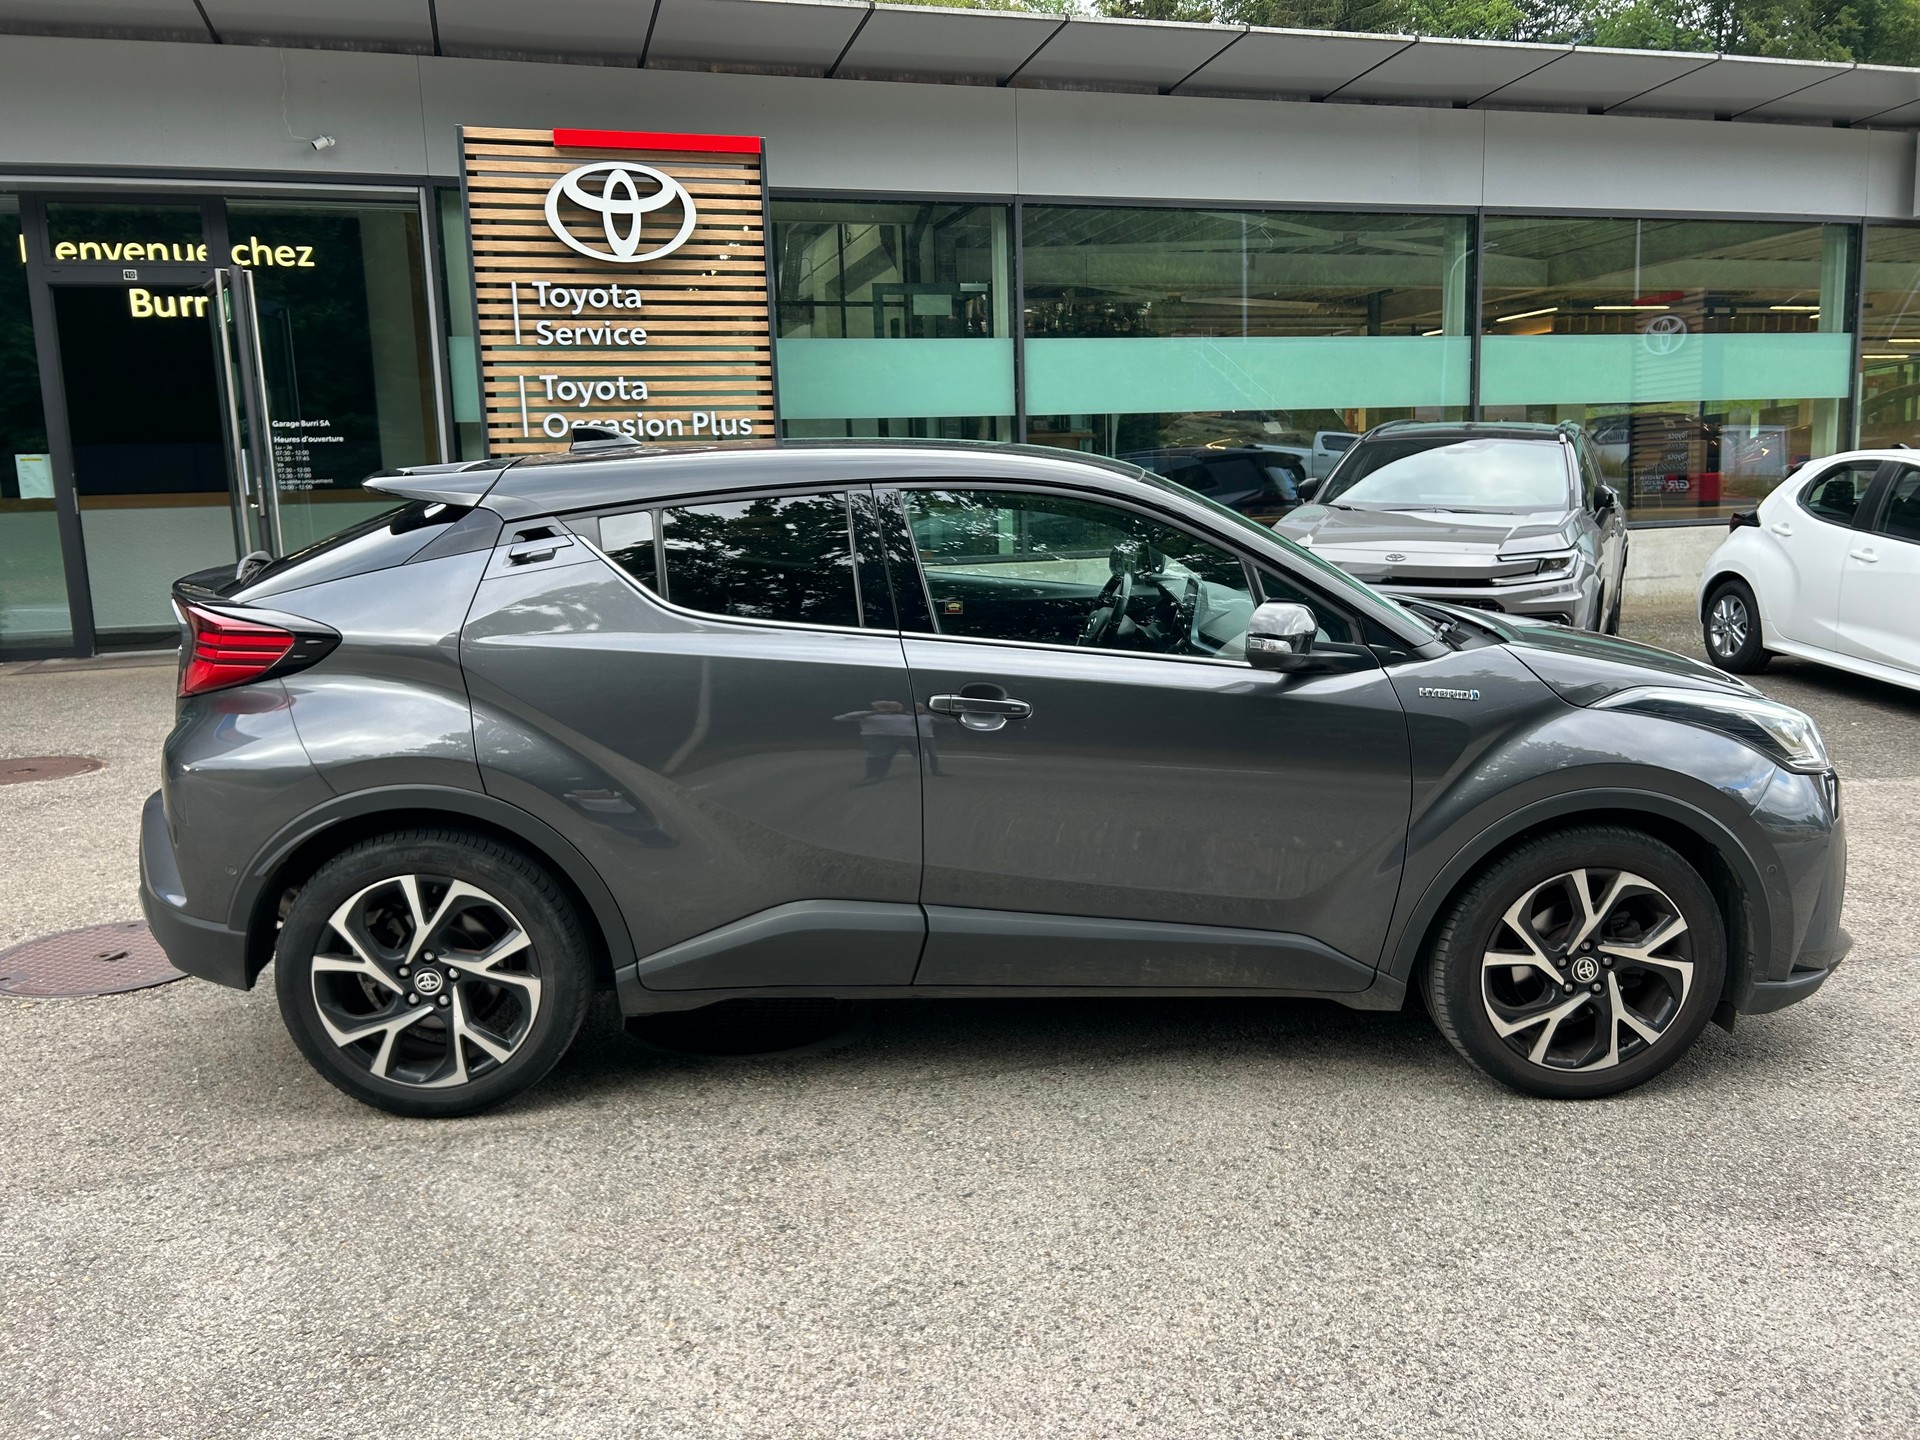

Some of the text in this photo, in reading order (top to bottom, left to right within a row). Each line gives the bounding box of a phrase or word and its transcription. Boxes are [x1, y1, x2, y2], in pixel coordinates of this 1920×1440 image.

[19, 233, 315, 267] envenue chez
[129, 288, 208, 318] Burr
[531, 281, 642, 315] Toyota
[536, 320, 647, 346] Service
[539, 374, 648, 408] Toyota
[272, 420, 300, 428] Garage
[692, 410, 753, 437] Plus
[301, 435, 344, 443] d'ouverture
[1418, 687, 1470, 699] HYBRID
